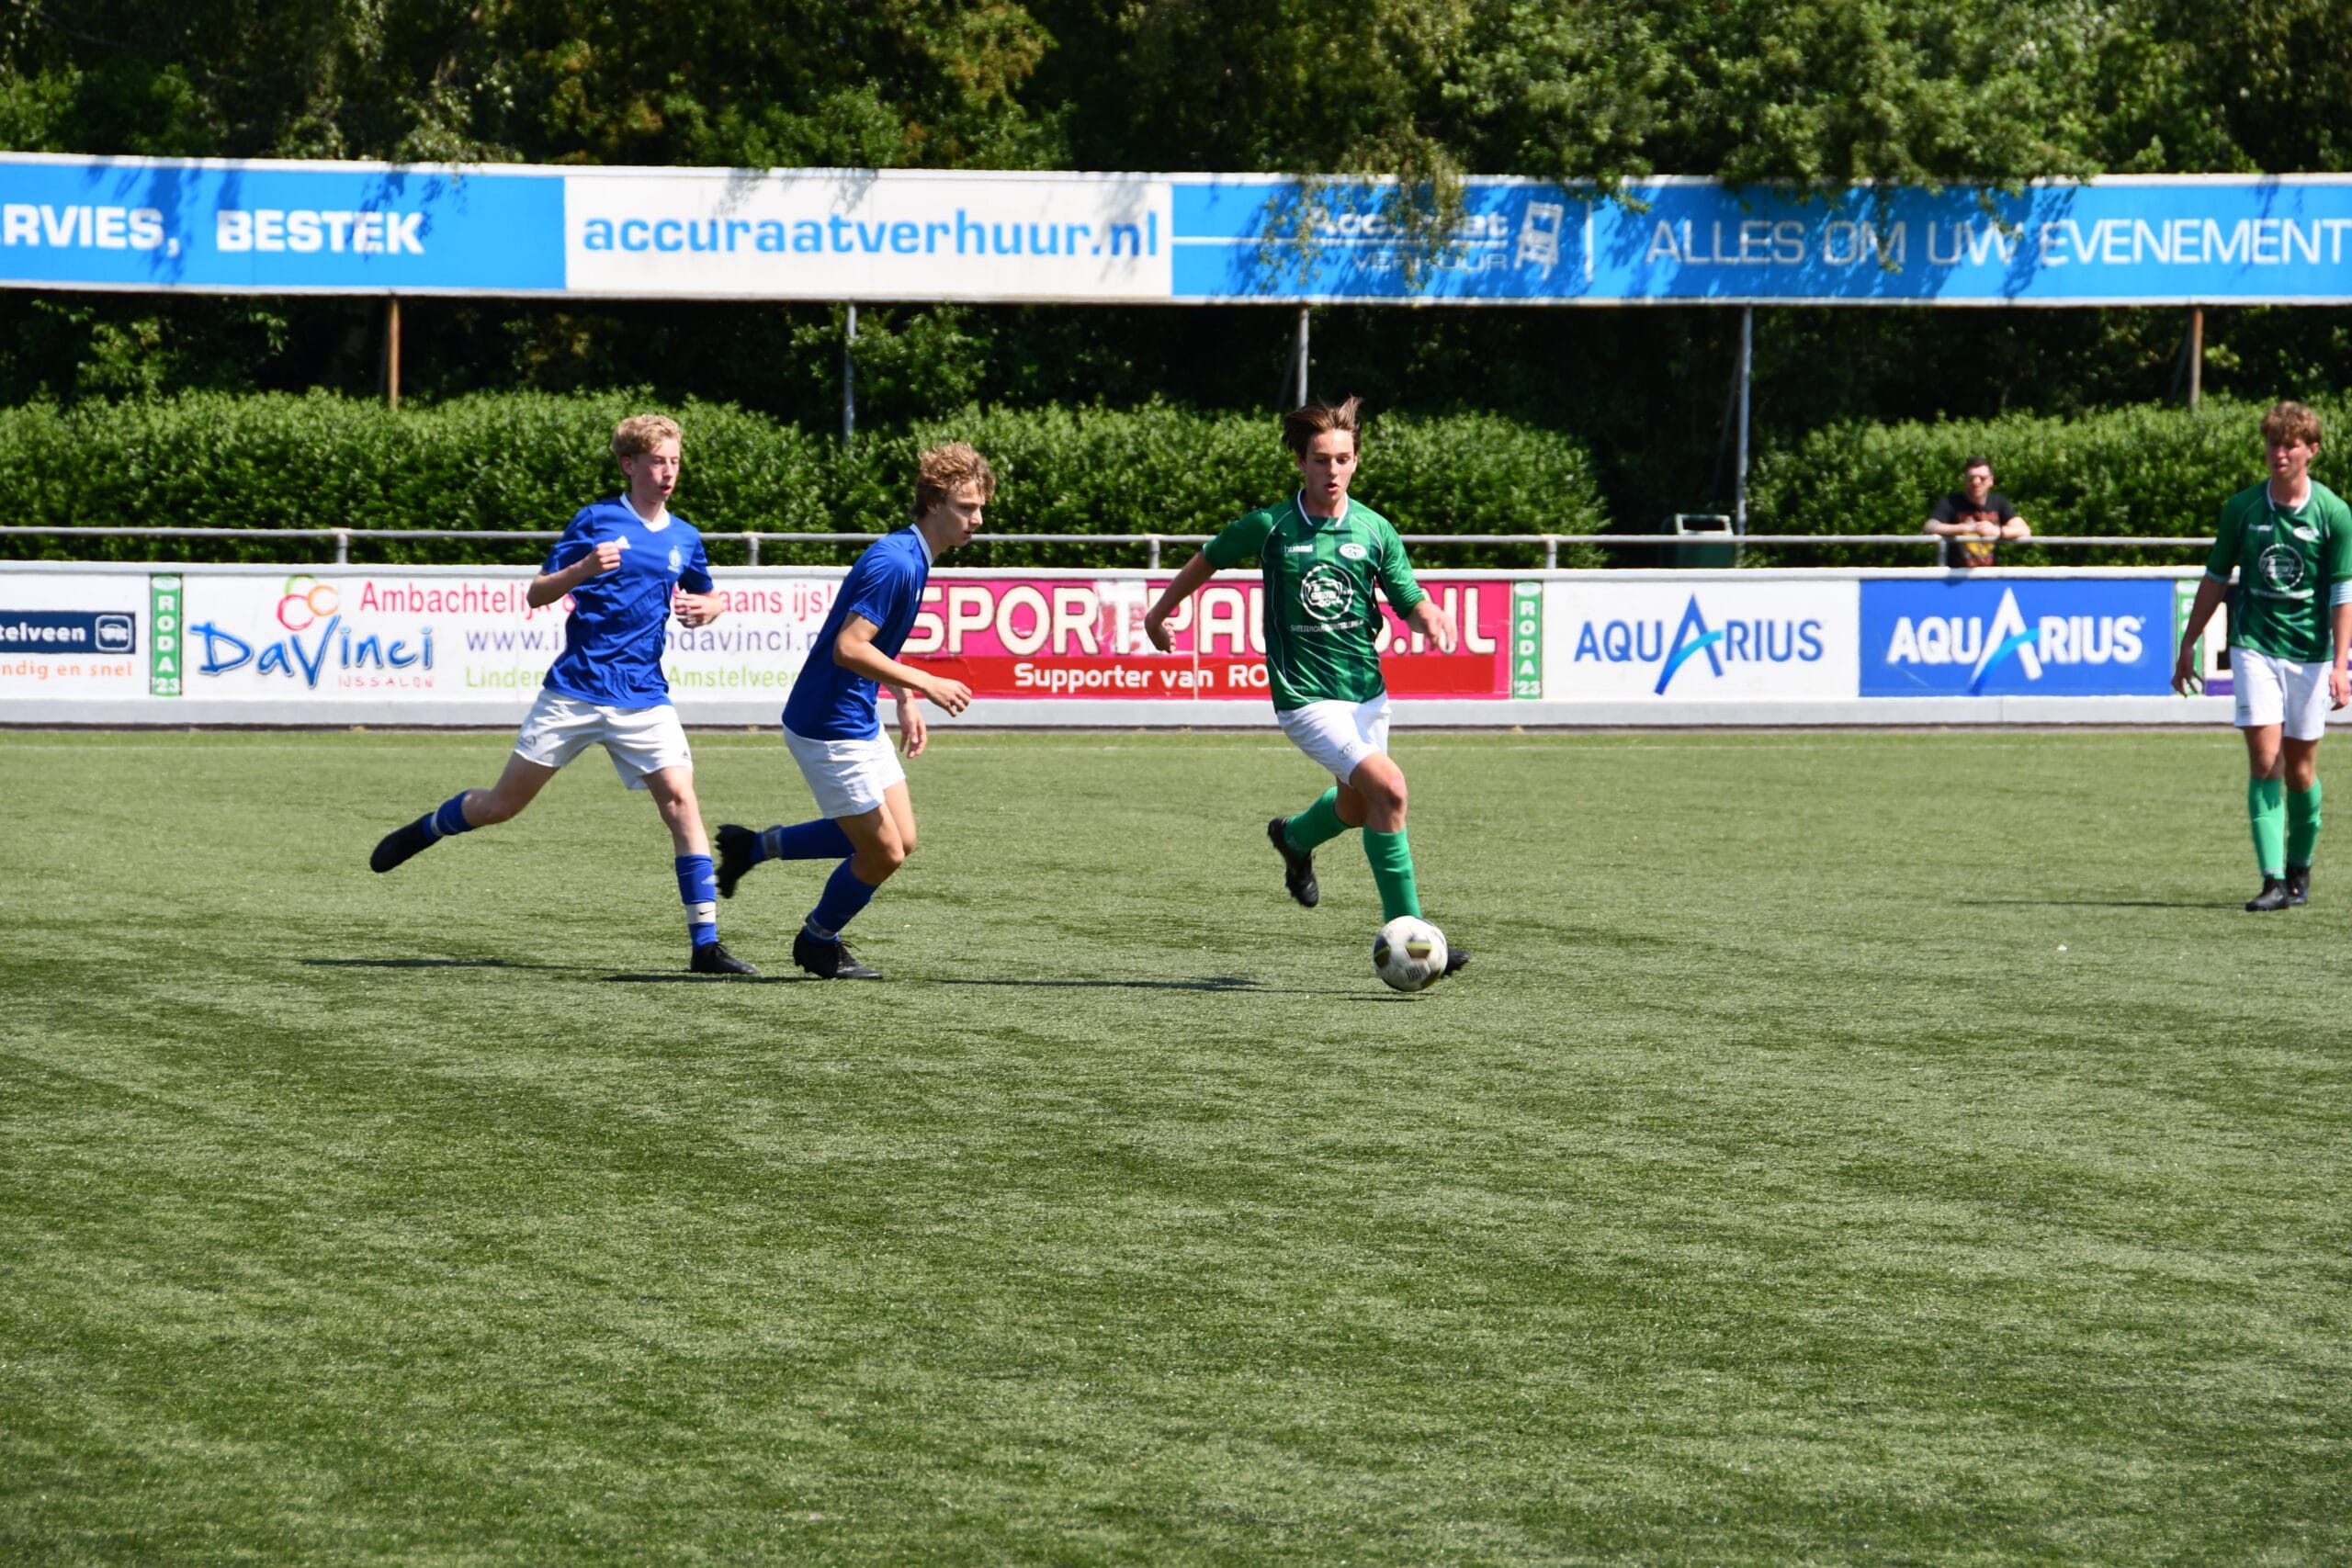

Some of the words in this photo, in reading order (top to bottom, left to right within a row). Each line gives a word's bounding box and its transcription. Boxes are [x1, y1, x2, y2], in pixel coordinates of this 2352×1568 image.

[3, 204, 179, 258] RVIES,
[216, 209, 425, 254] BESTEK
[582, 209, 1158, 257] accuraatverhuur.nl
[1645, 220, 1804, 265] ALLES
[1824, 220, 1906, 265] OM
[1928, 220, 2022, 265] UW
[2040, 219, 2352, 265] EVENEMENT
[157, 595, 175, 672] RODA
[189, 615, 433, 690] DaVinci
[1519, 600, 1536, 675] RODA
[1573, 592, 1824, 695] AQUARIUS
[1885, 586, 2144, 695] AQUARIUS
[57, 666, 81, 676] en
[90, 661, 132, 677] snel
[338, 676, 435, 688] IJSSALON
[1013, 662, 1153, 694] Supporter
[1159, 669, 1215, 688] van
[1227, 663, 1270, 688] RO
